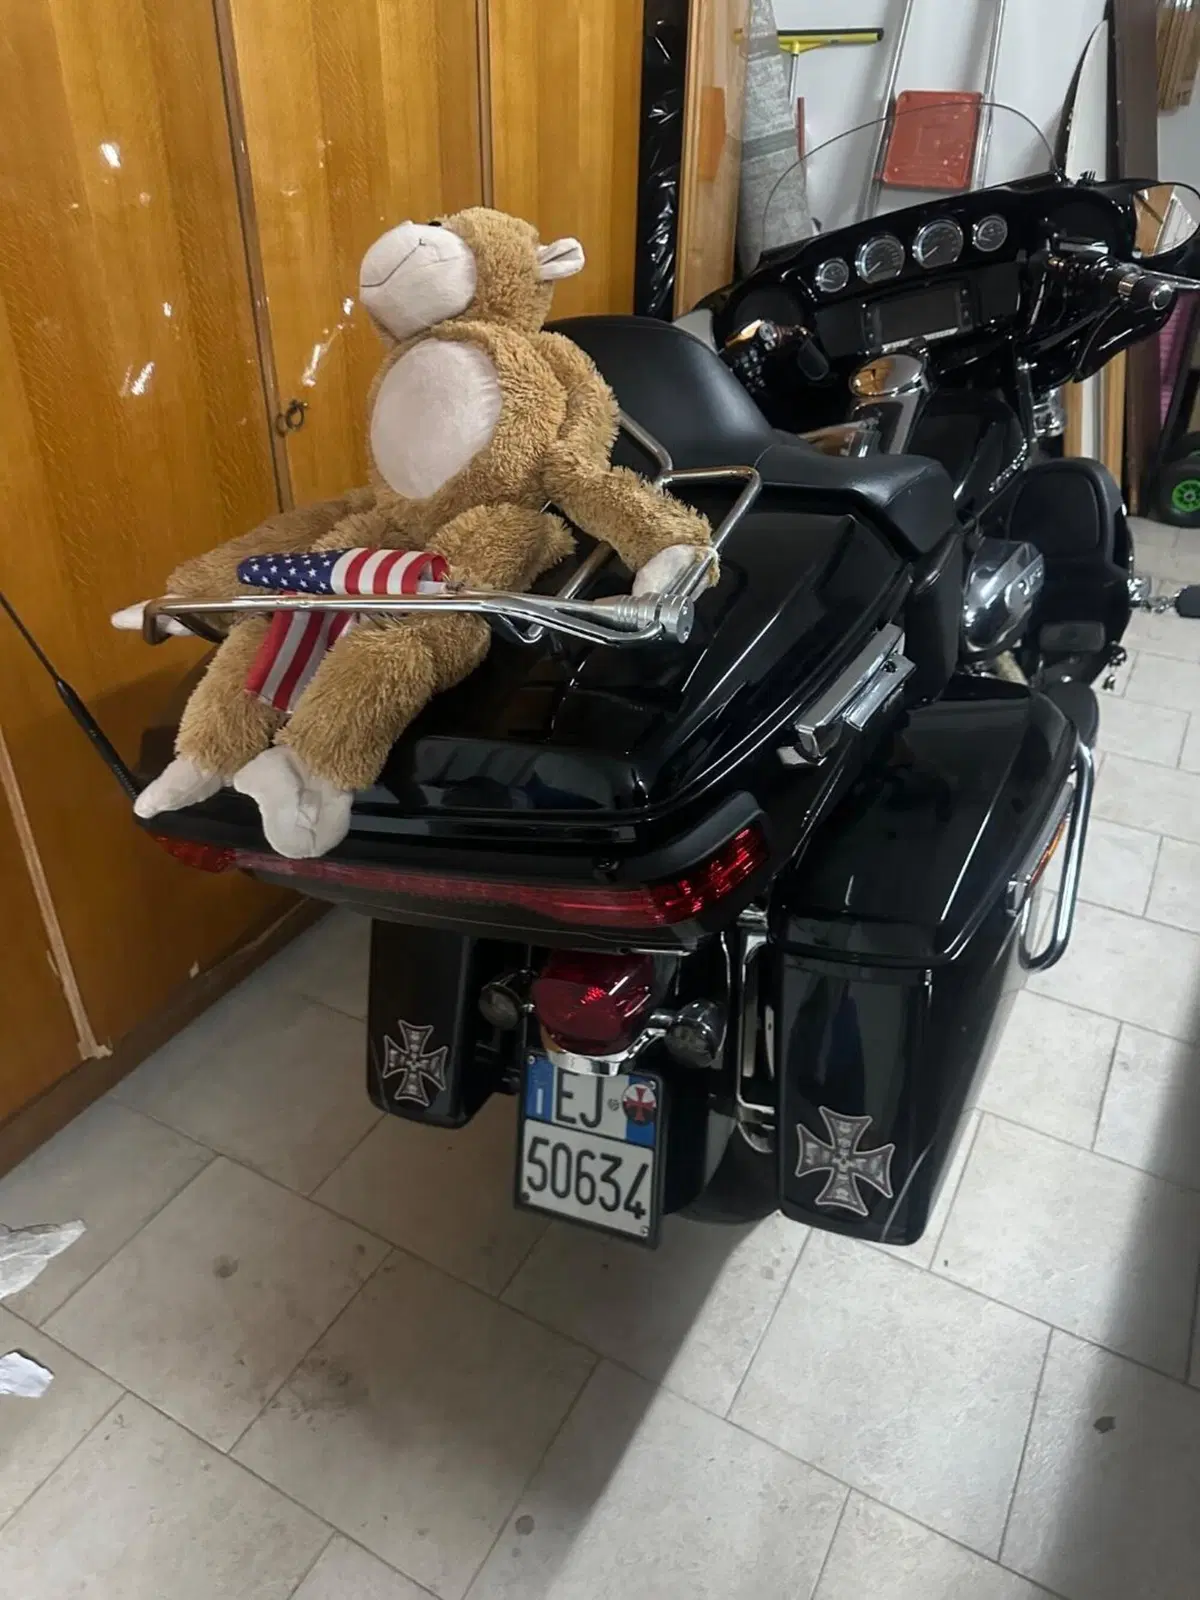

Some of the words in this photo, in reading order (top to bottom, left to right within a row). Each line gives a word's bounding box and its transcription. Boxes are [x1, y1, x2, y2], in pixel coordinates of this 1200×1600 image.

[536, 1088, 544, 1114] I
[556, 1067, 604, 1128] EJ
[527, 1136, 649, 1220] 50634
